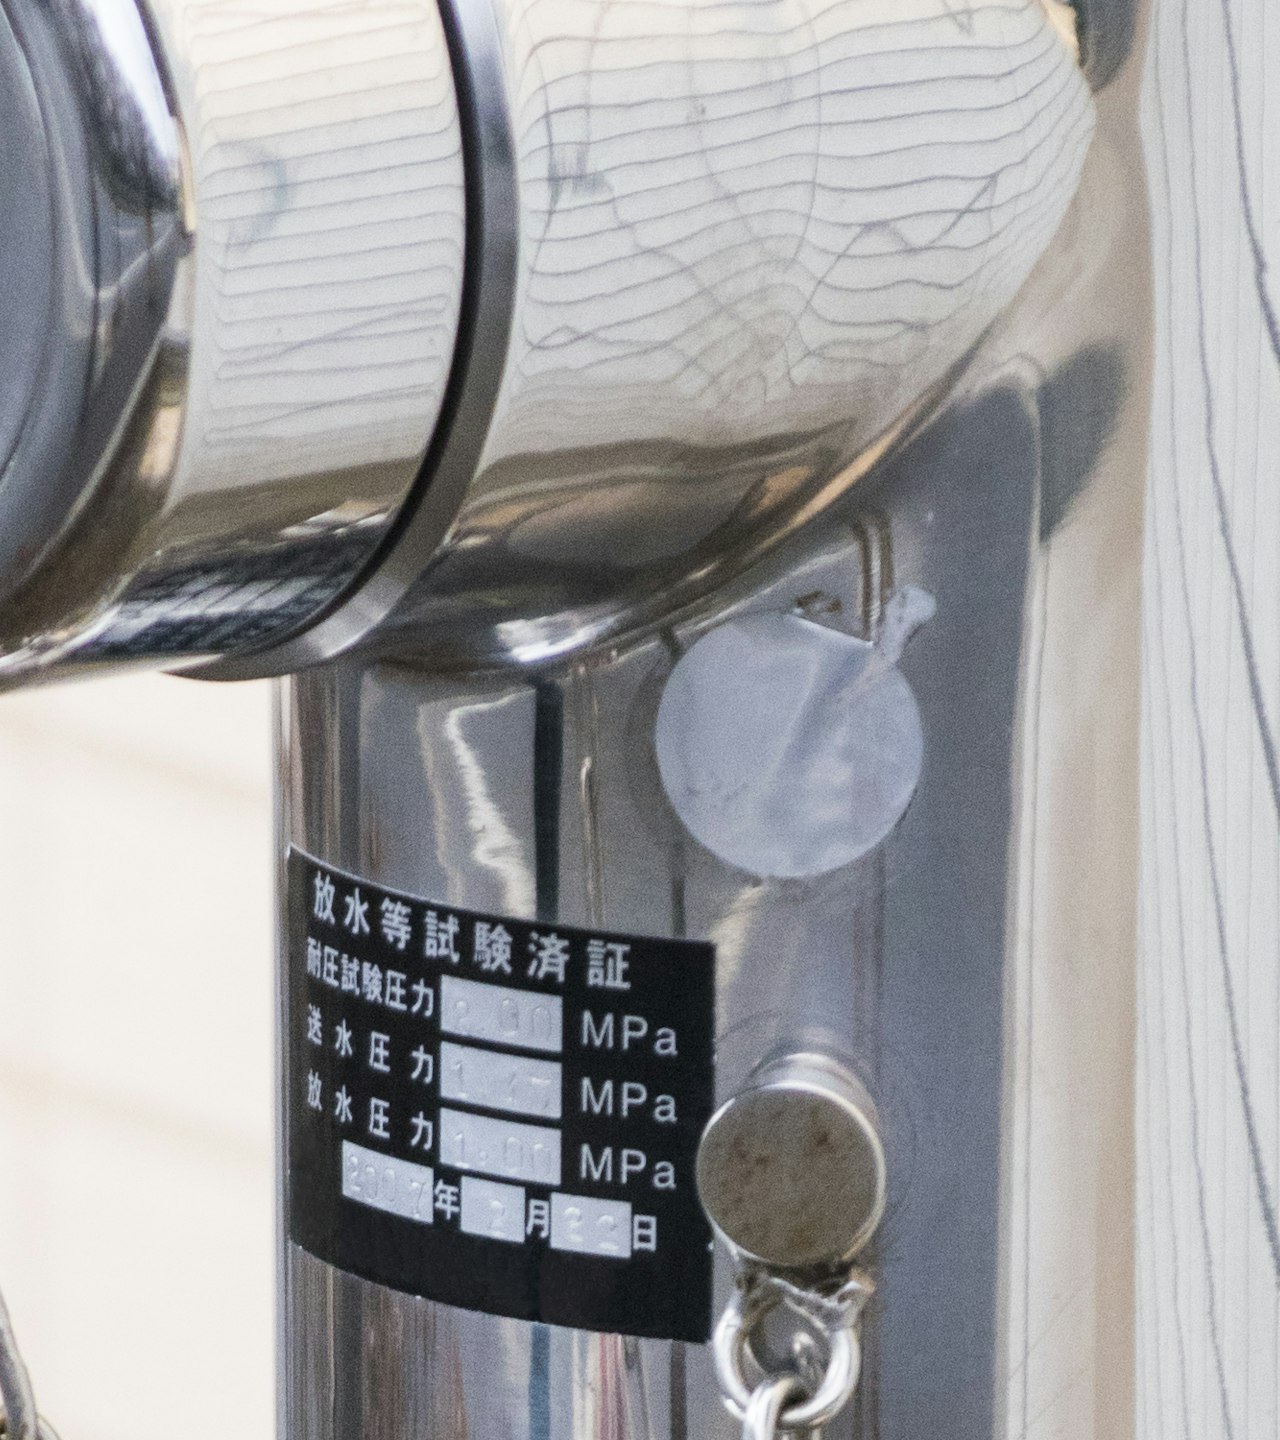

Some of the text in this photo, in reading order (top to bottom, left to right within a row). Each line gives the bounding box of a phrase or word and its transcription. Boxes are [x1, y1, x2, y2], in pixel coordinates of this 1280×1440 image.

[312, 870, 632, 990] 放水等試験済証
[306, 935, 435, 1018] 耐圧試験圧力
[580, 1009, 679, 1056] MPa
[580, 1076, 678, 1124] MPa
[579, 1142, 678, 1191] MPa
